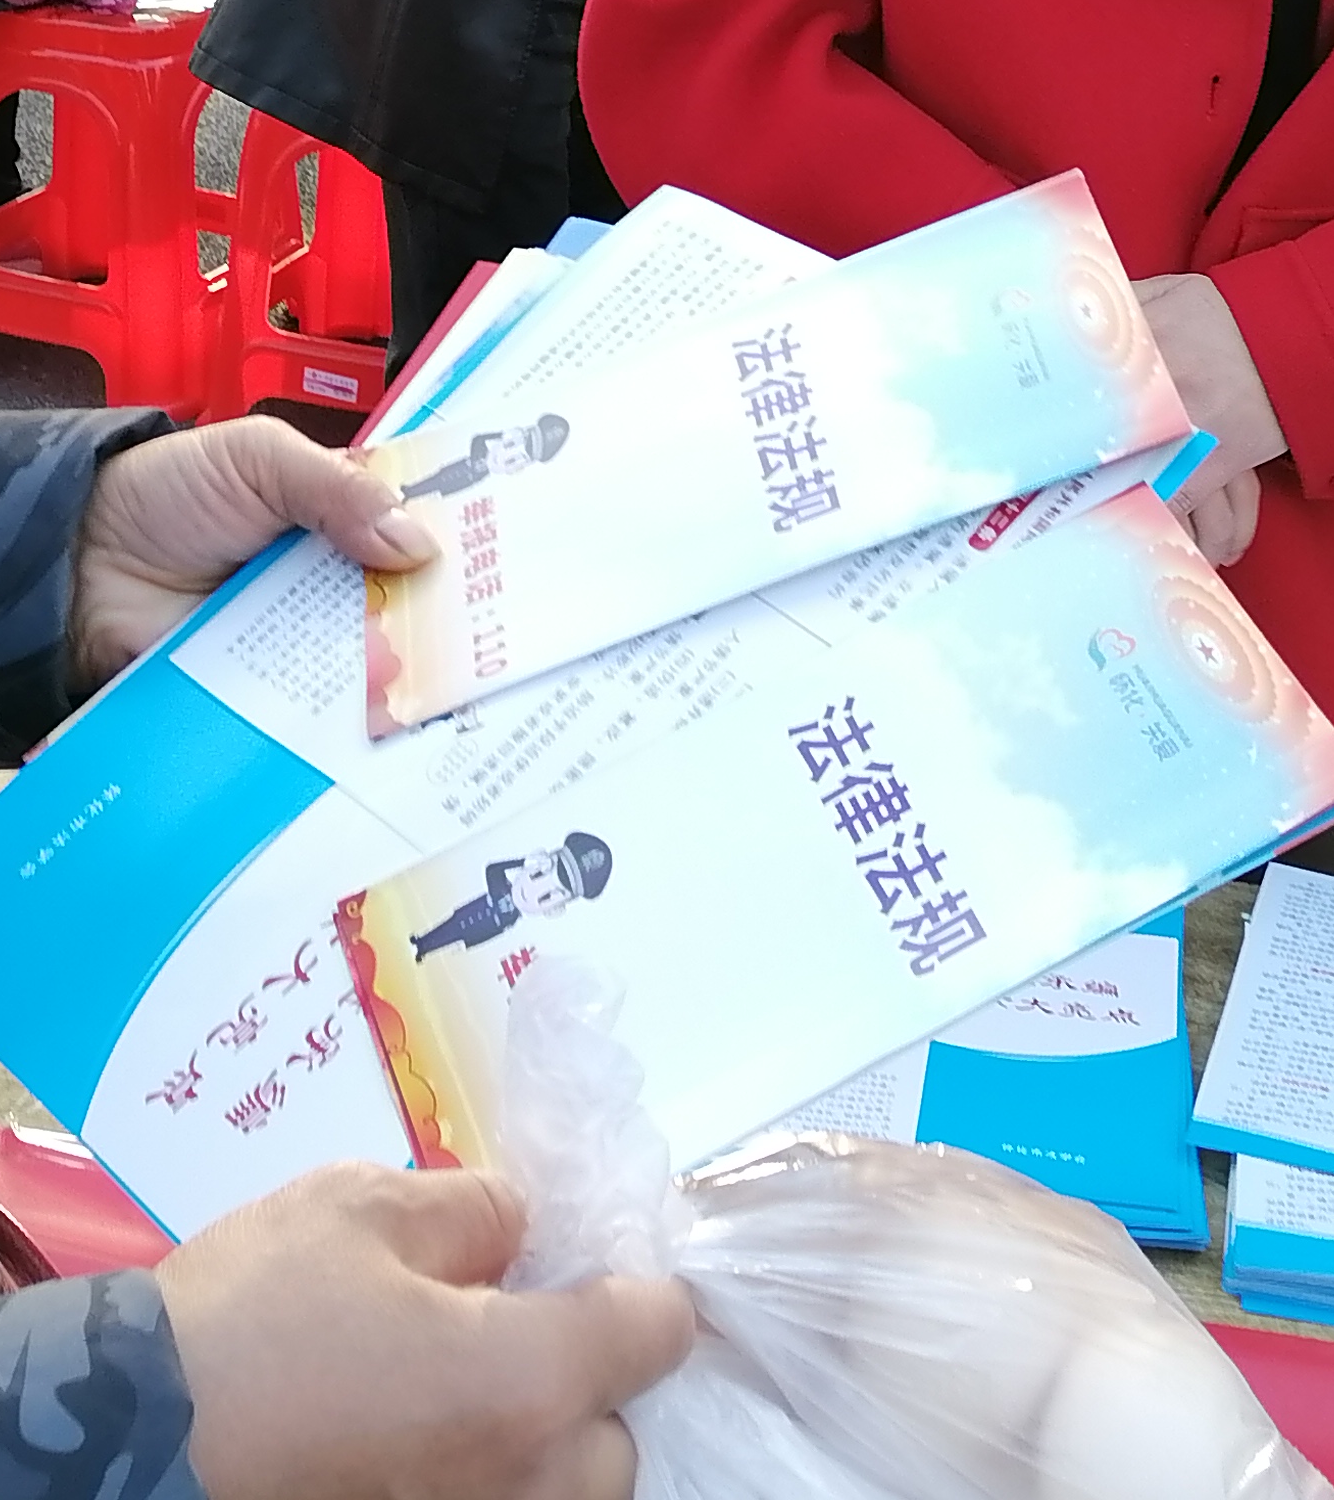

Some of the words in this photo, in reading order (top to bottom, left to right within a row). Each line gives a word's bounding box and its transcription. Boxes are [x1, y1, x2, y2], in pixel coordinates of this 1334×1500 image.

[731, 322, 841, 534] 法律法规
[787, 695, 993, 977] 法律法规
